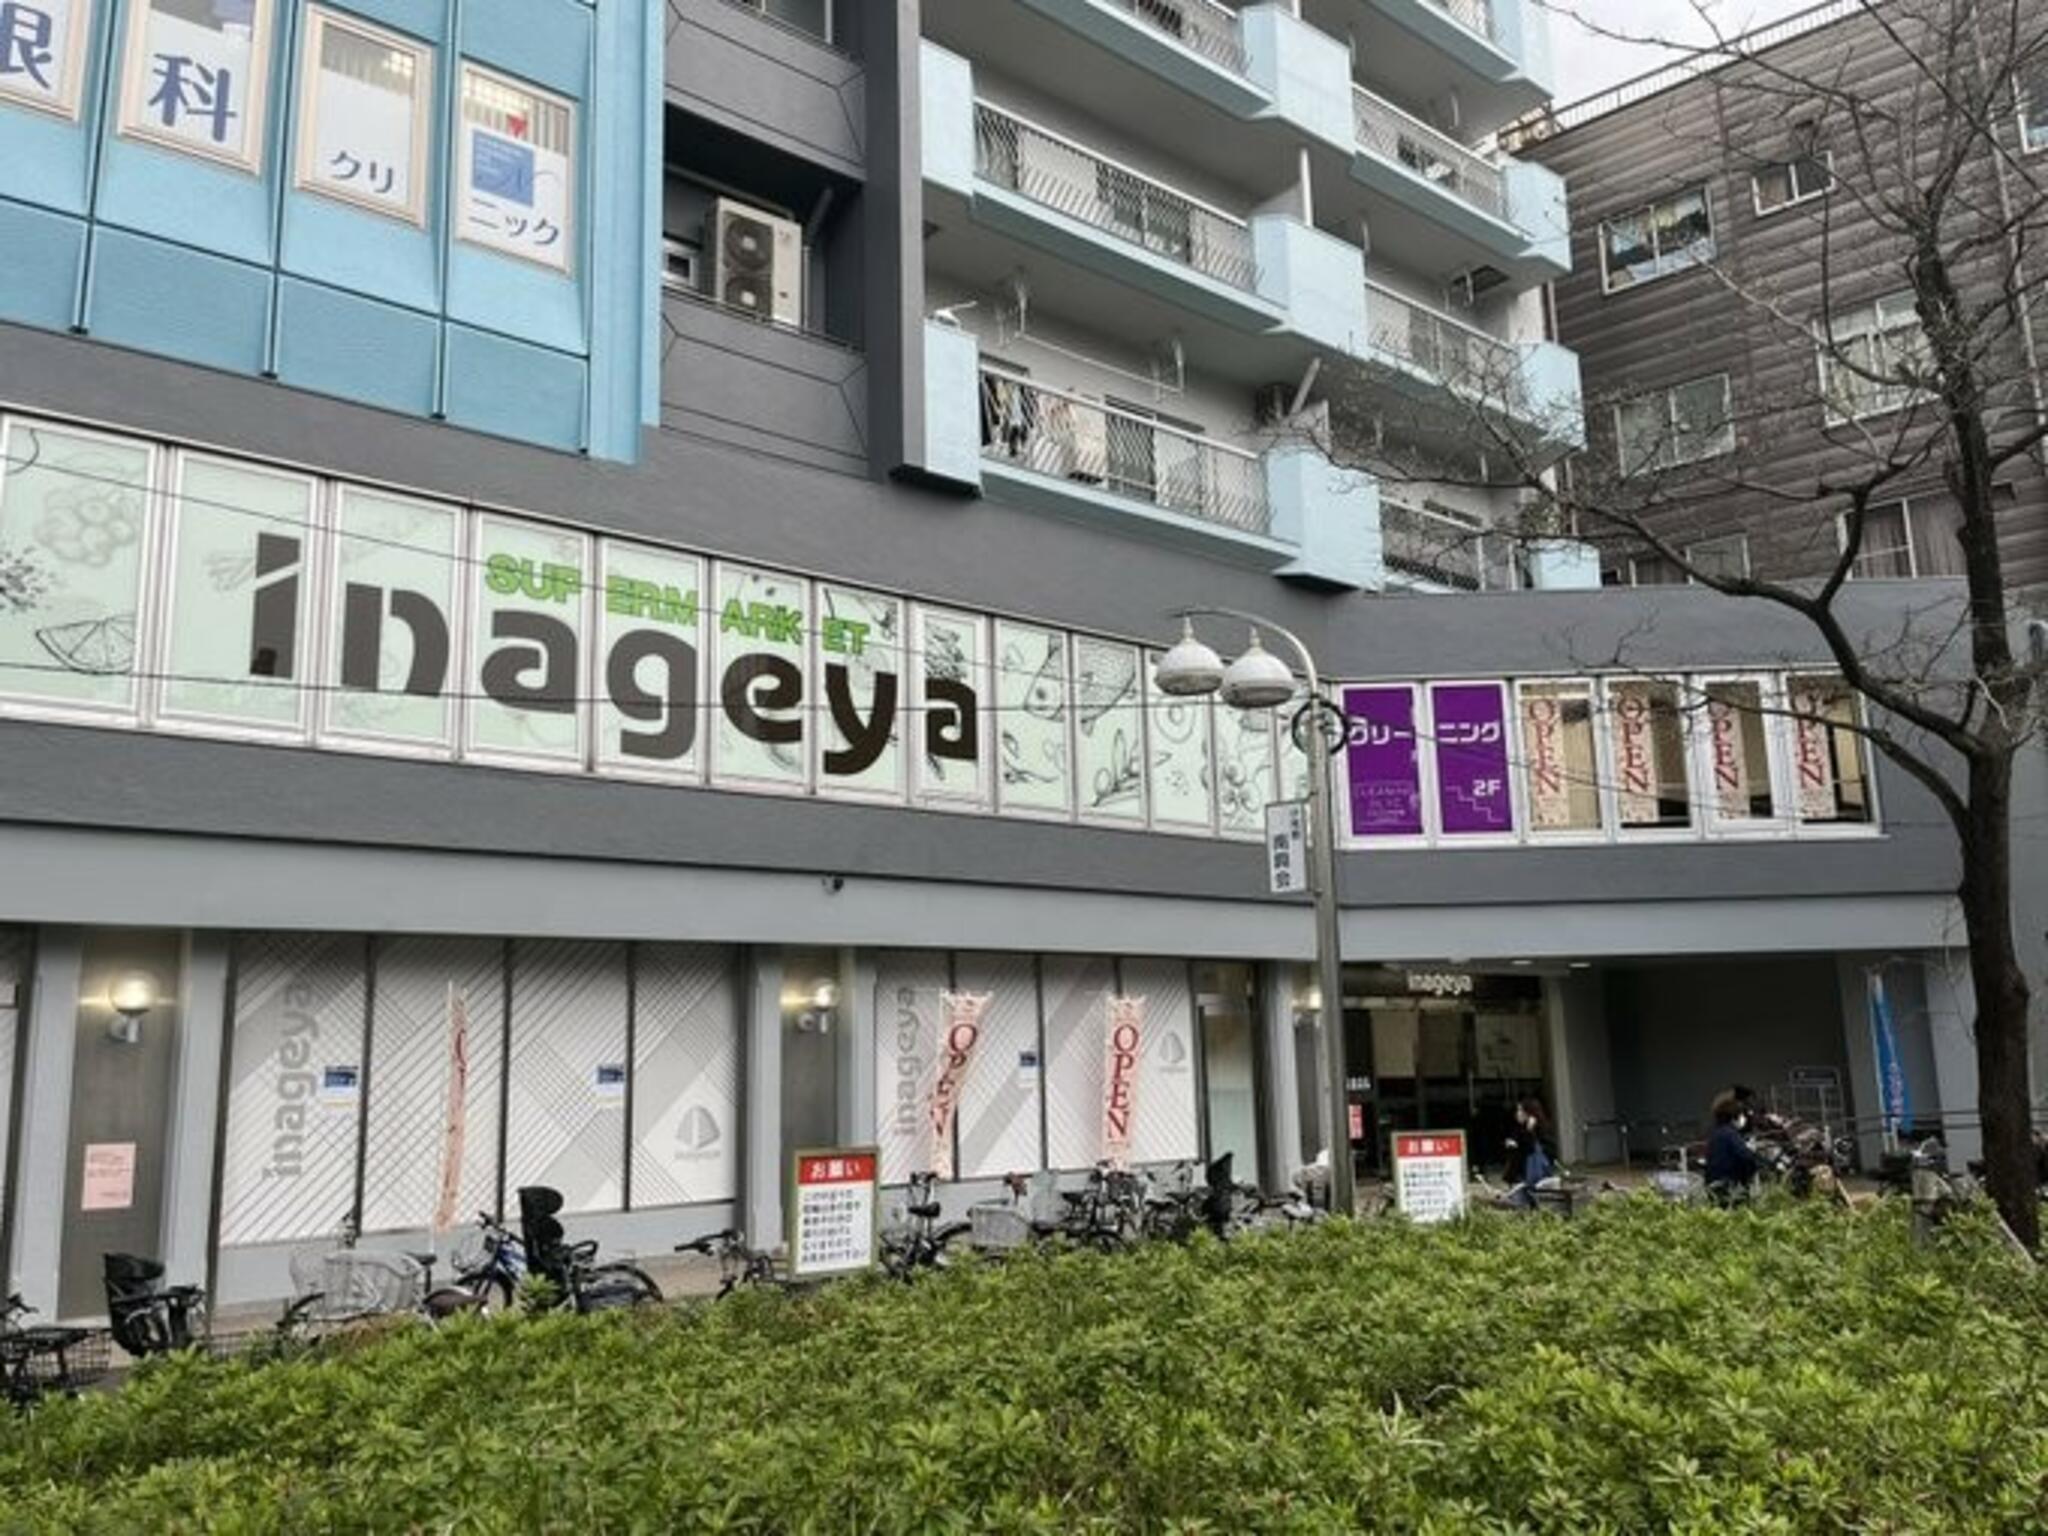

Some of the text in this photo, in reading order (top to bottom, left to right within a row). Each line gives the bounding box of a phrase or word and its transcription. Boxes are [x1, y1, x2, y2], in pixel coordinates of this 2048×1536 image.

[249, 532, 978, 775] inageya
[485, 552, 870, 655] SUPERMARKET
[1472, 778, 1502, 797] 2F
[1529, 698, 1561, 795] OPEN
[1617, 697, 1650, 792] OPEN
[263, 982, 320, 1180] inageya
[895, 986, 922, 1136] inageya
[1107, 1023, 1140, 1139] OPEN
[811, 1159, 862, 1180] お願い
